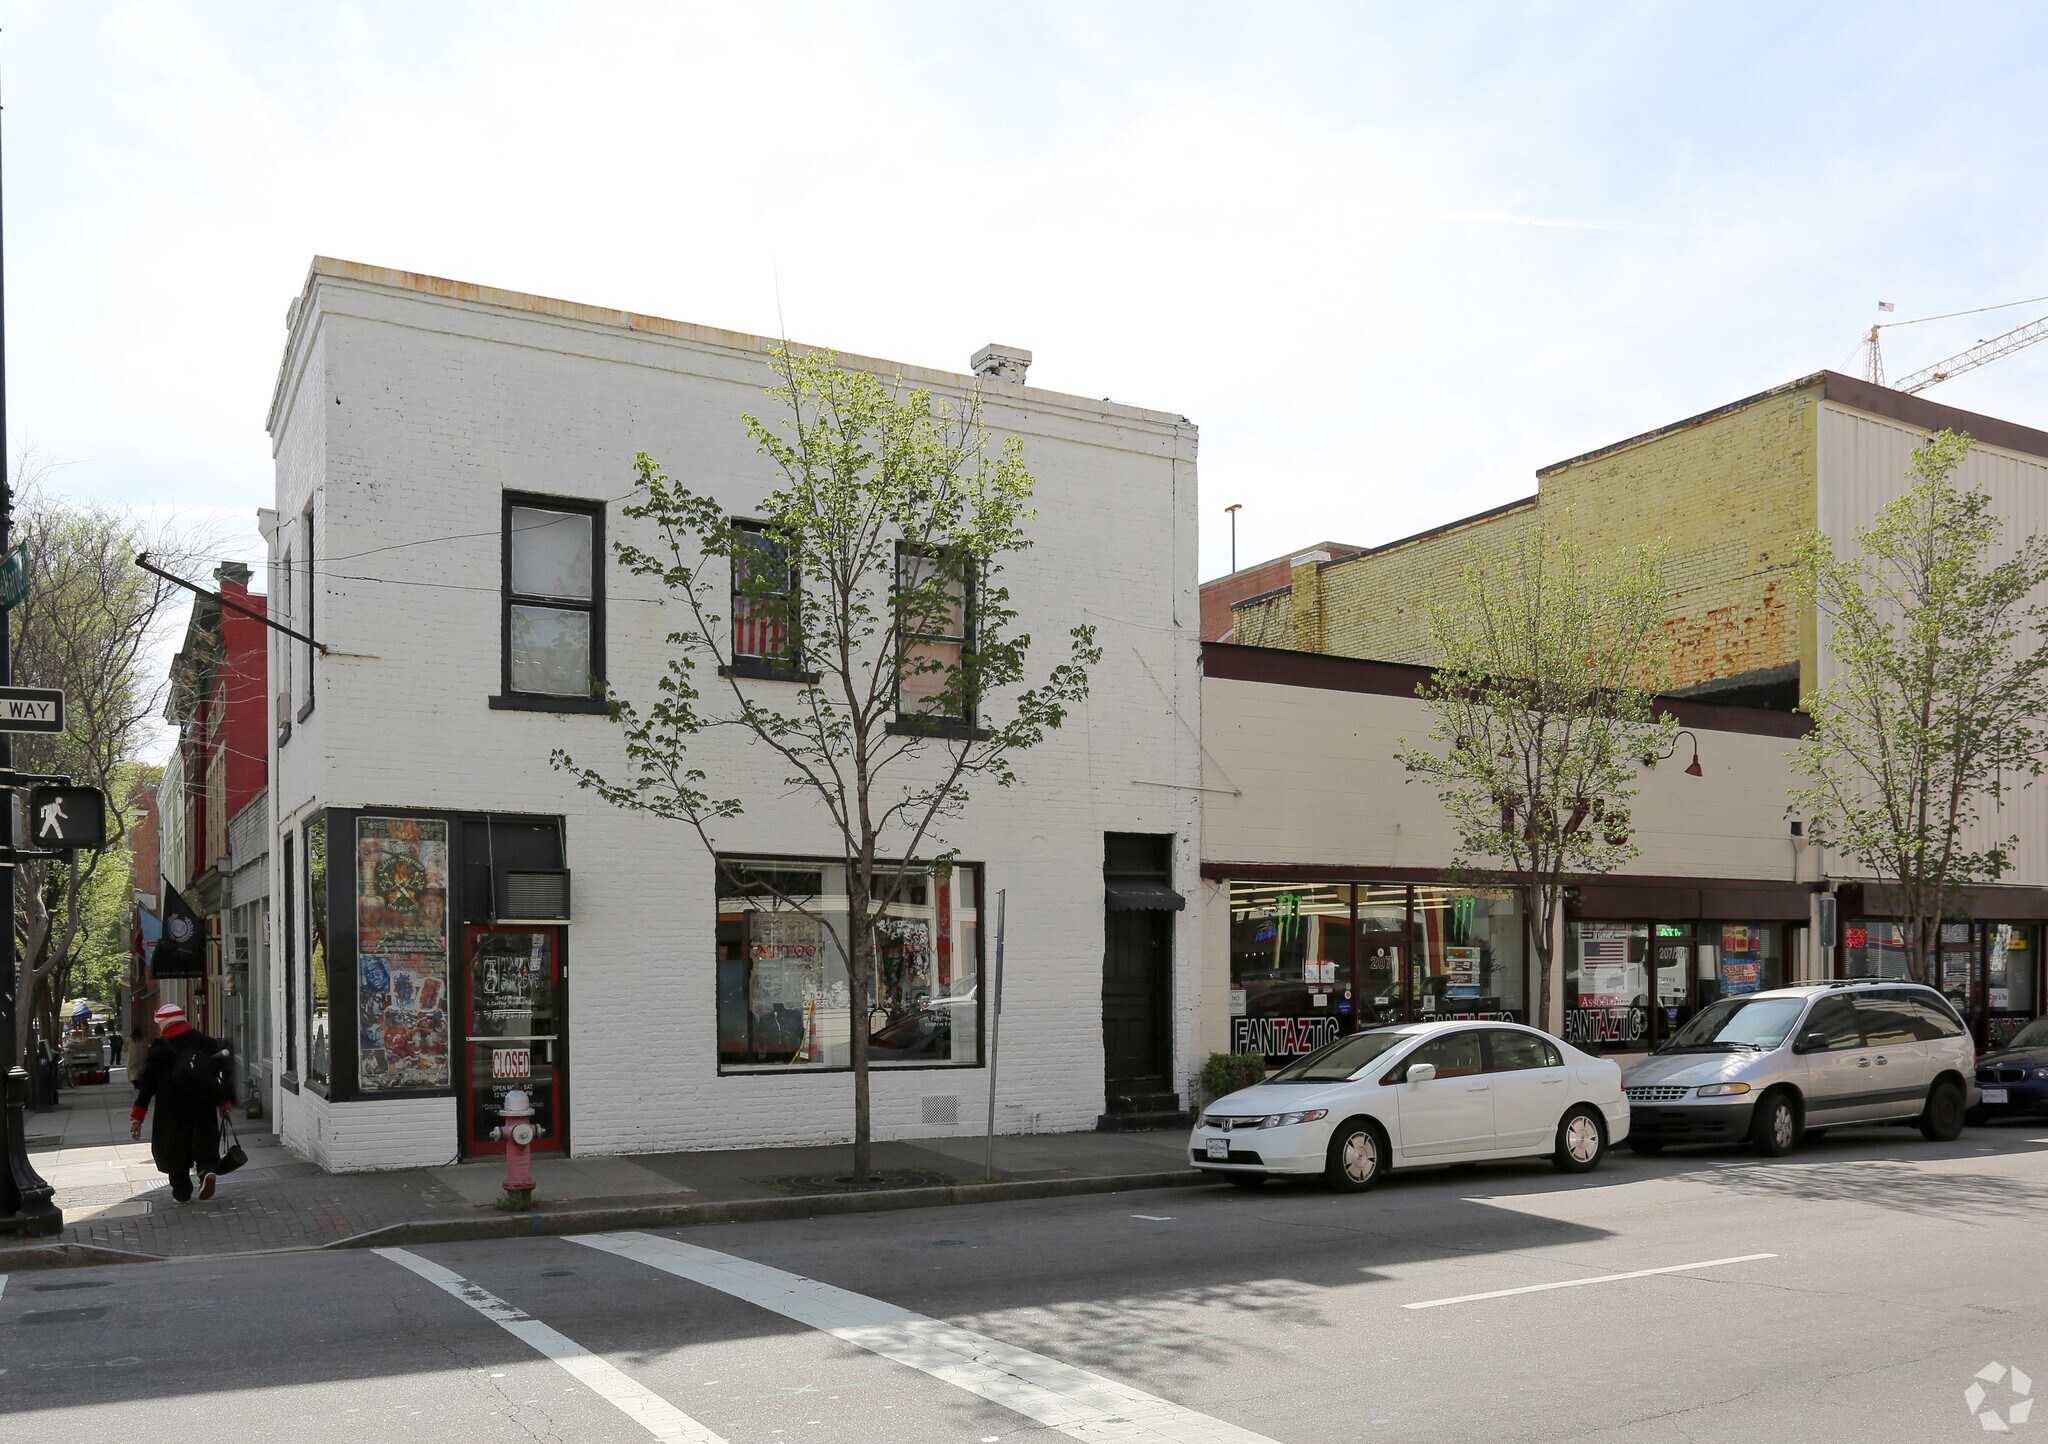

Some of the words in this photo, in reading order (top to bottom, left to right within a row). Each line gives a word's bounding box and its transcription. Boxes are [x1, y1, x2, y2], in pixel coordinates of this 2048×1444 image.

[9, 702, 49, 719] WAY
[1370, 956, 1393, 969] 207
[1235, 1016, 1340, 1057] FANTAZTIC
[494, 1051, 530, 1078] CLOSED
